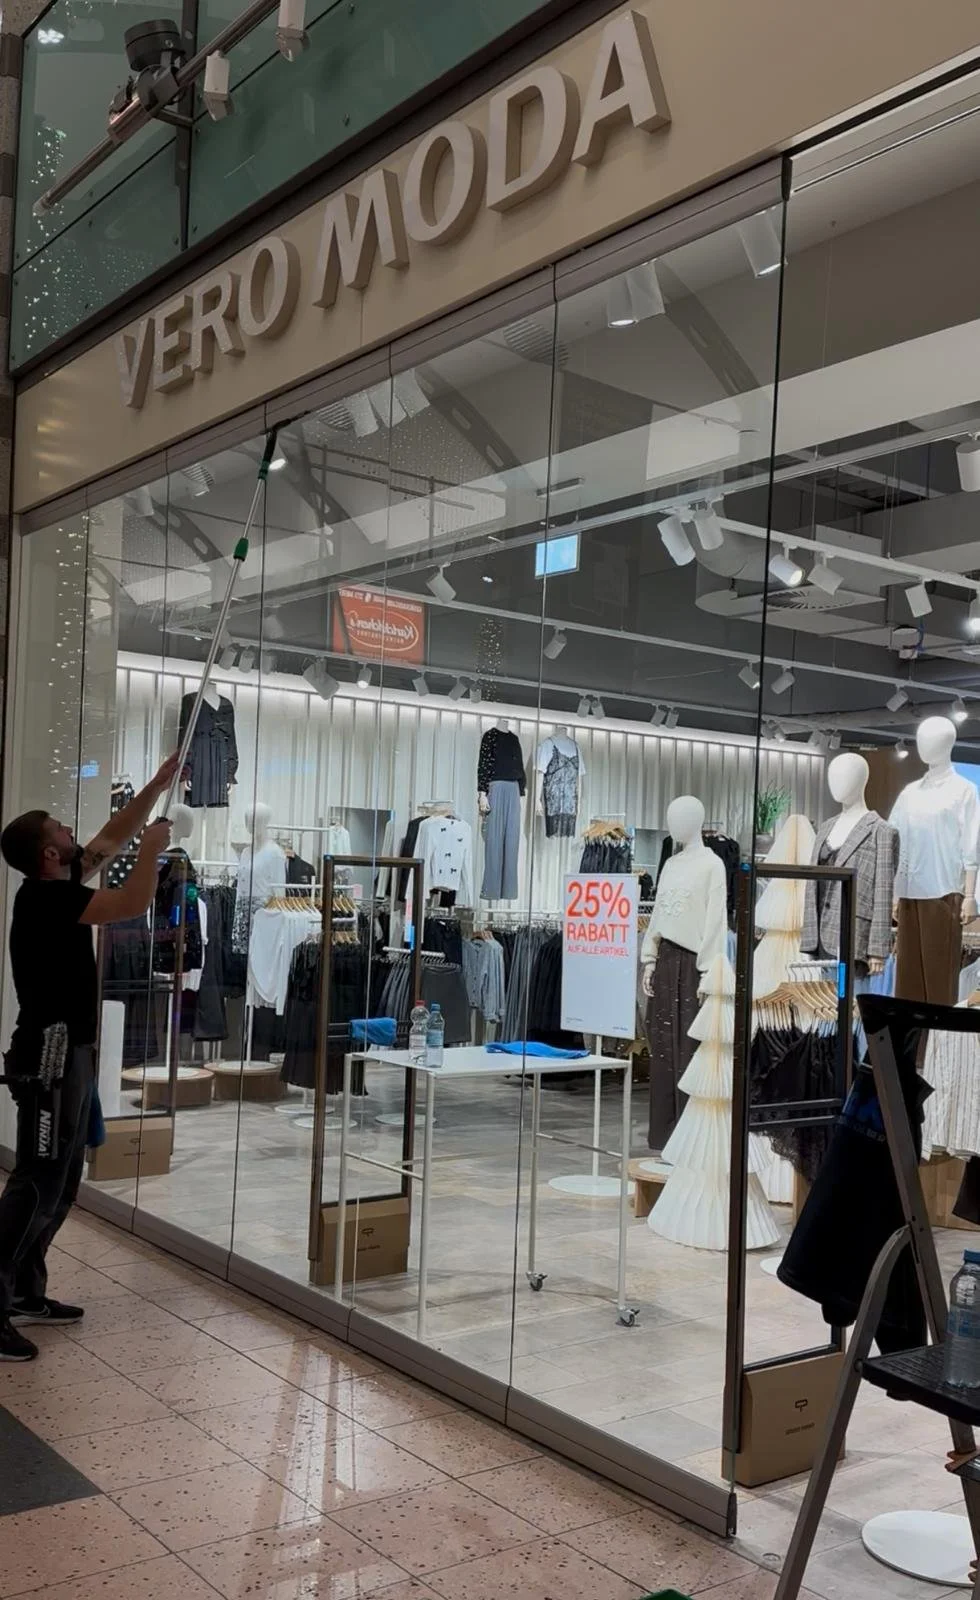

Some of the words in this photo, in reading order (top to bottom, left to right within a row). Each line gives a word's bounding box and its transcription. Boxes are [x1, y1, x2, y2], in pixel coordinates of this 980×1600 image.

[118, 236, 299, 408] VERO
[314, 9, 671, 308] MODA
[567, 881, 631, 919] 25%
[567, 922, 630, 943] RABATT
[568, 944, 581, 953] AUF
[581, 945, 600, 955] ALLE
[600, 946, 629, 957] ARTIKEL
